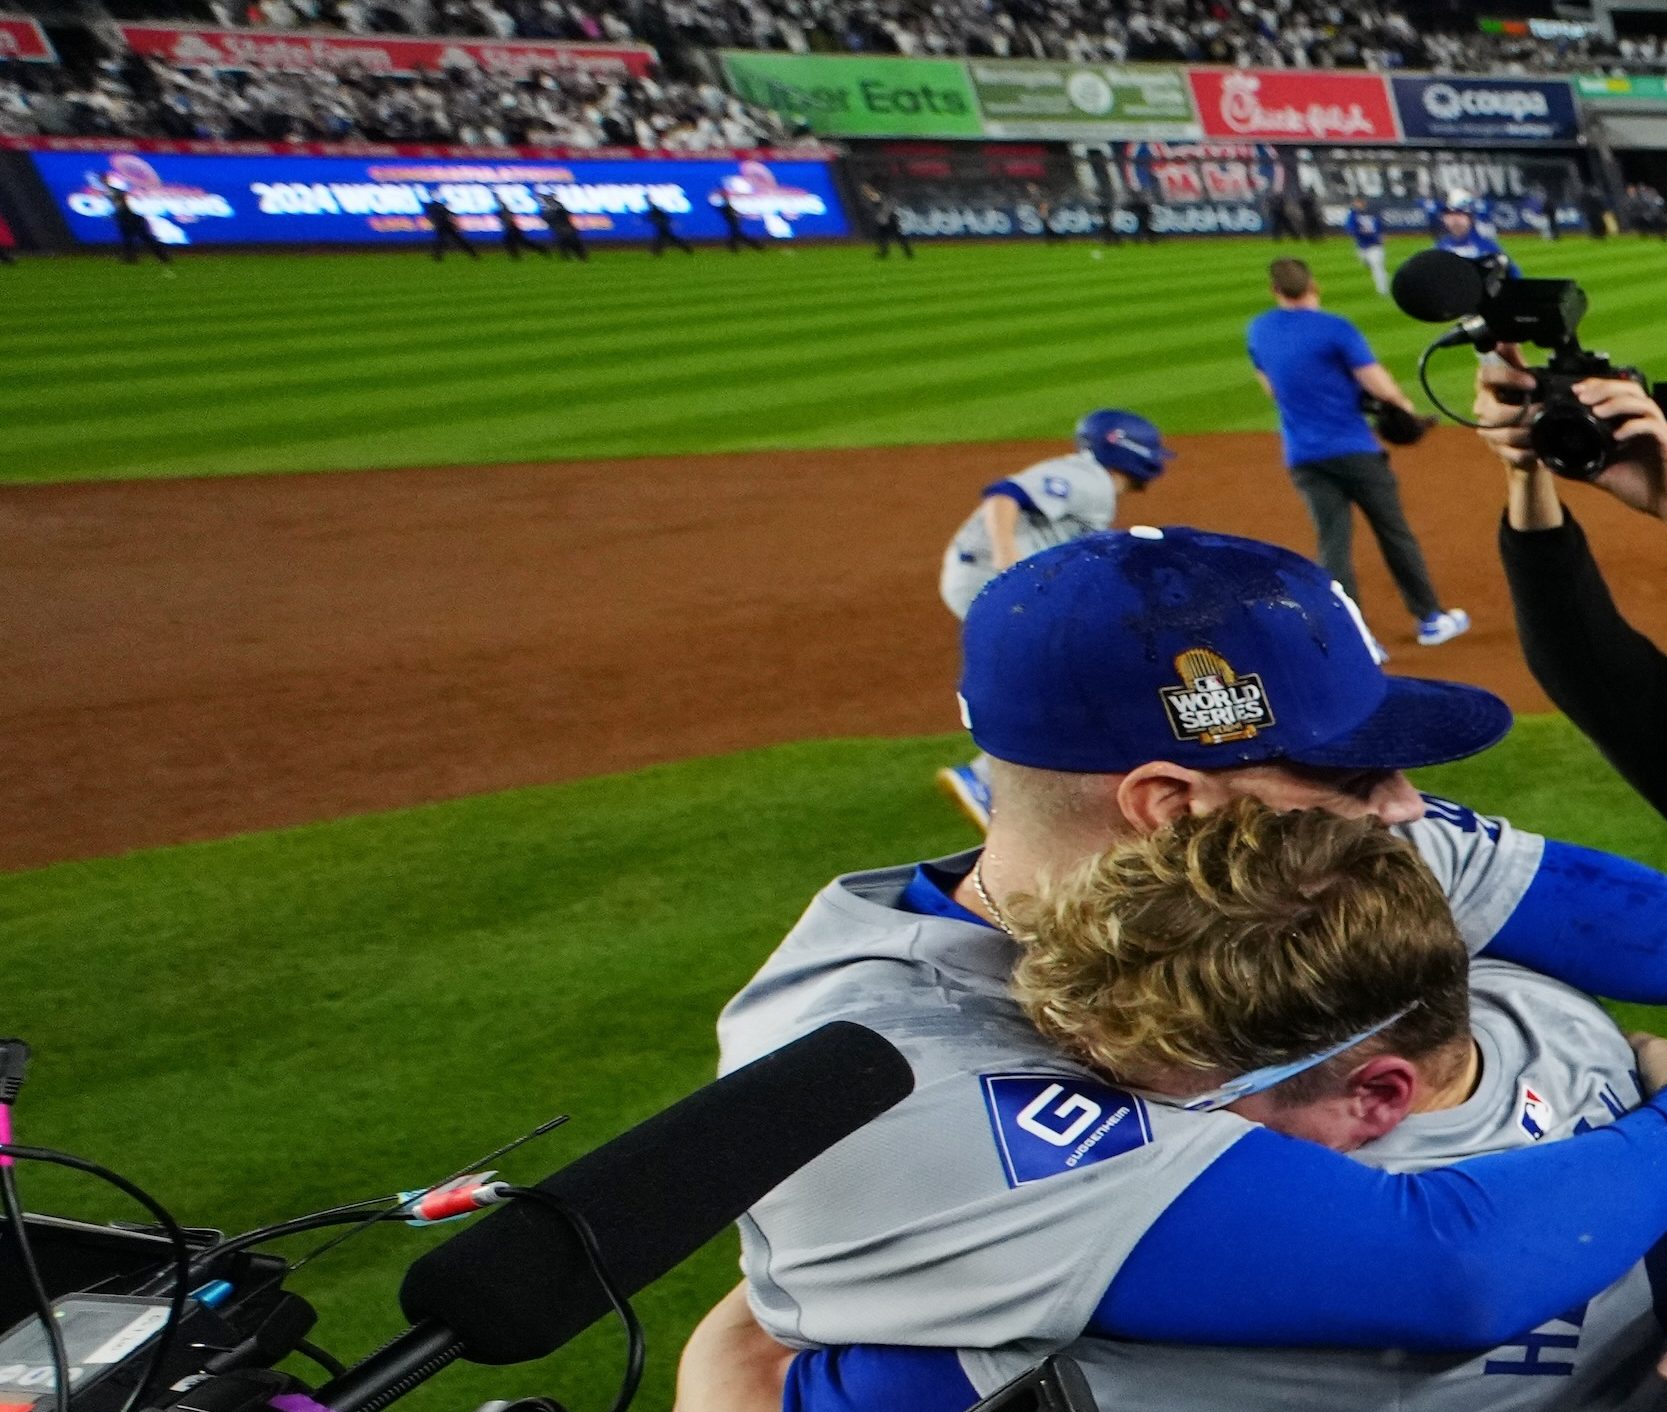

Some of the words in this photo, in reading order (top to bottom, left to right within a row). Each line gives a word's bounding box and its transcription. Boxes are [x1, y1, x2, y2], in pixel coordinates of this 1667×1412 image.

[860, 79, 967, 116] Eats
[1168, 684, 1261, 714] WORLD
[1179, 701, 1264, 729] SERIES
[1016, 1082, 1102, 1147] G
[1065, 1105, 1131, 1168] GUGGENHEIM
